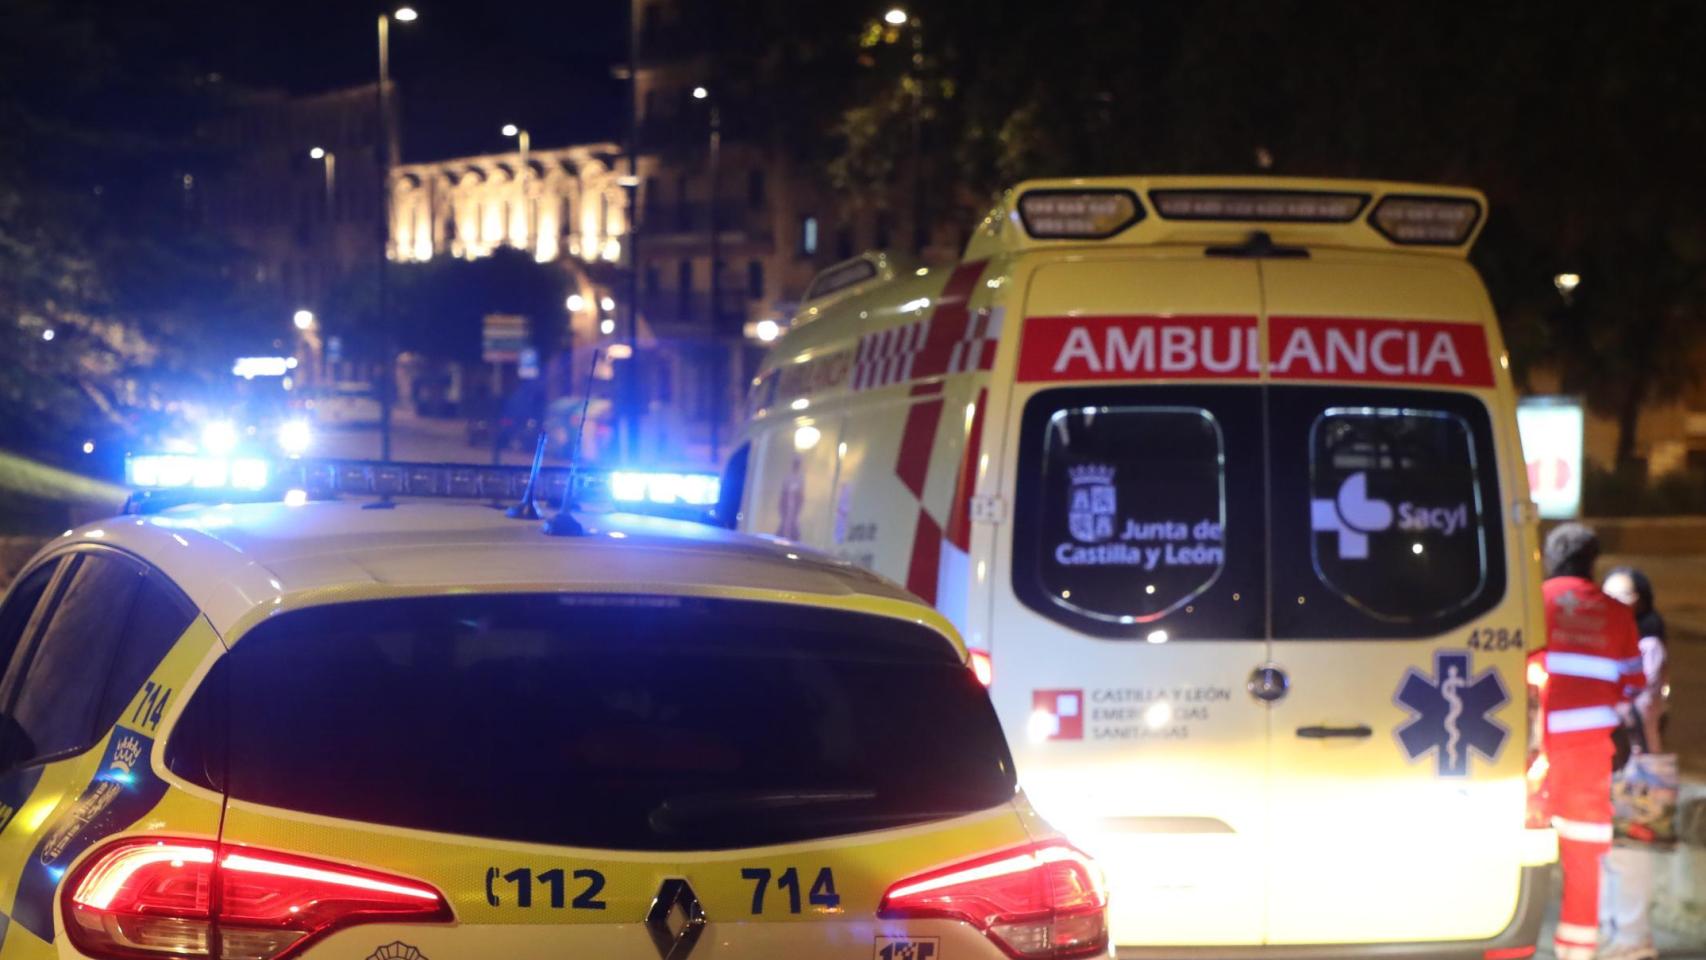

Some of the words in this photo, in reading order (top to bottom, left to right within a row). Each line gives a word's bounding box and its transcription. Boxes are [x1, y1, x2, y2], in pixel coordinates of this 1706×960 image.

[1053, 325, 1464, 377] AMBULANCIA
[1120, 518, 1188, 540] Junta
[1192, 519, 1222, 540] de
[1398, 502, 1467, 536] Sacyl
[1055, 542, 1141, 565] Castilla
[1143, 546, 1161, 571] y
[1164, 541, 1224, 565] León
[1467, 627, 1523, 651] 4284
[132, 680, 172, 732] 714
[1091, 687, 1169, 703] CASTILLA
[1172, 687, 1182, 702] Y
[1184, 684, 1232, 703] LEÓN
[1091, 706, 1210, 721] EMERCIAS
[1091, 725, 1190, 740] SANITAAS
[503, 867, 607, 910] 112
[741, 866, 841, 915] 714
